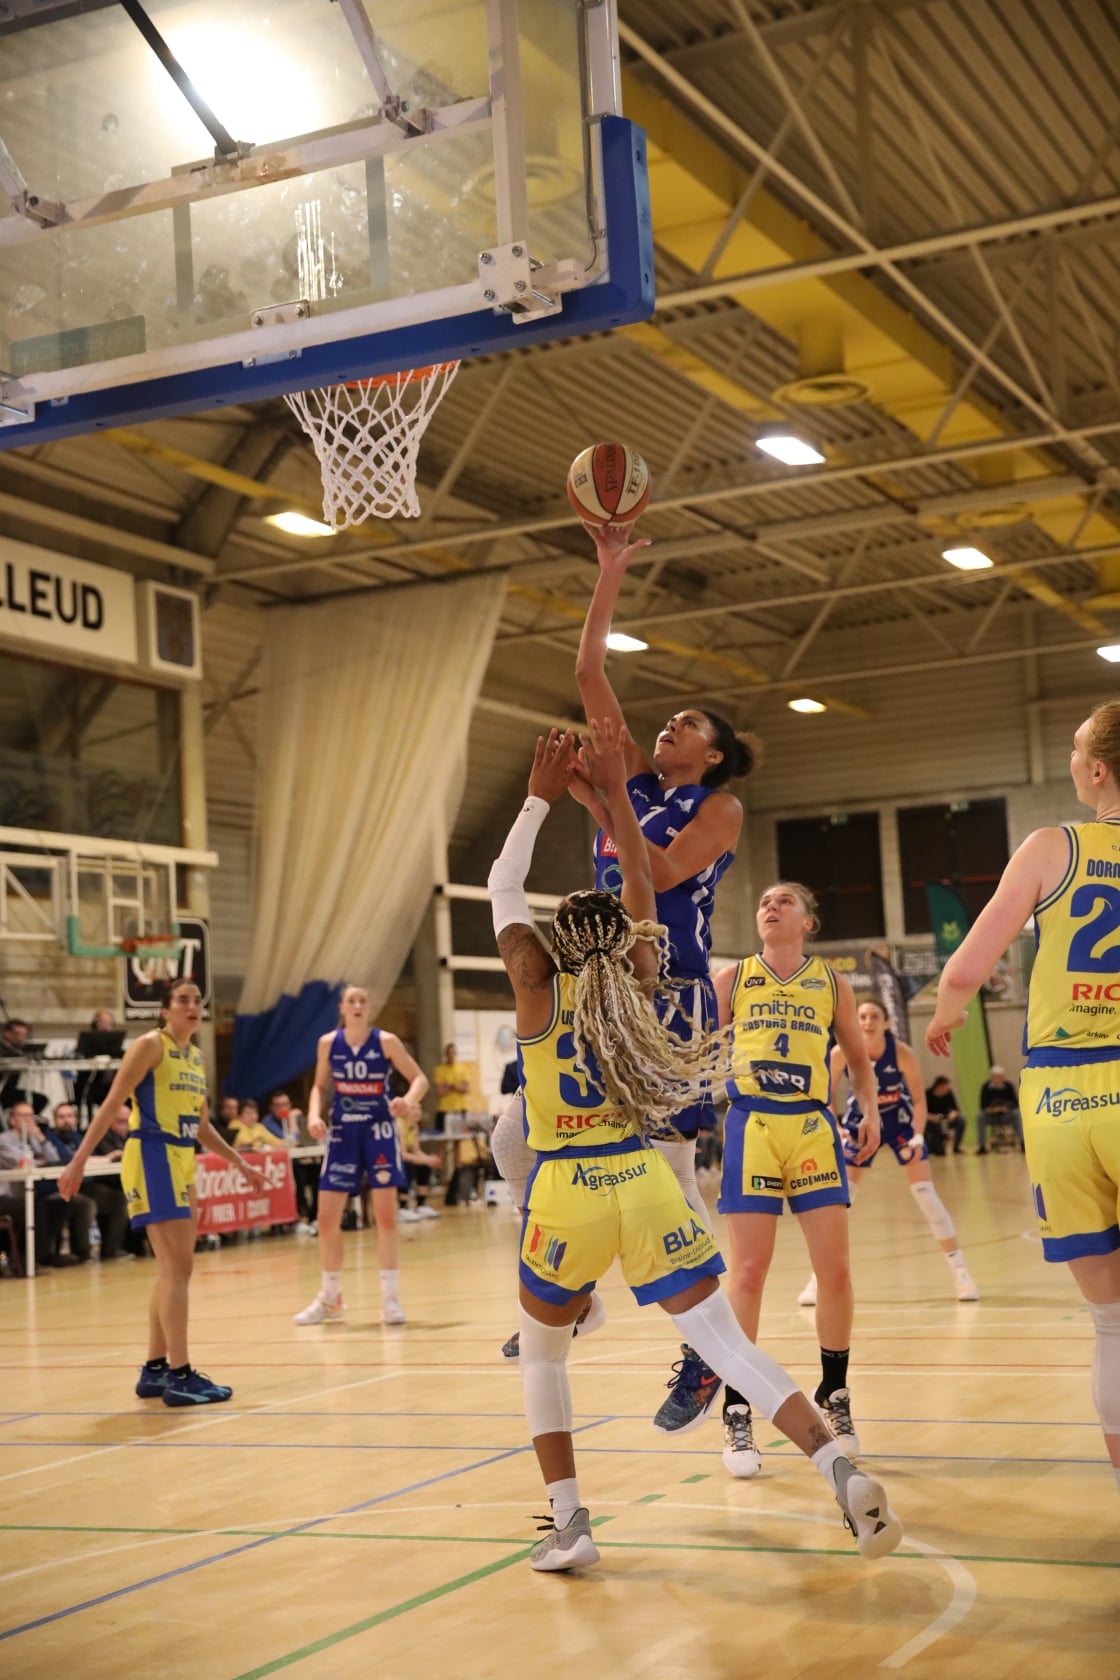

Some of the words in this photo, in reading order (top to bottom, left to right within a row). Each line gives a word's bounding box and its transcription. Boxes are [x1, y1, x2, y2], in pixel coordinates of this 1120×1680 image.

[0, 561, 104, 631] LEUD
[750, 1000, 815, 1019] mithra
[774, 1033, 789, 1058] 4
[344, 1061, 367, 1079] 10
[556, 1031, 607, 1108] 3
[371, 1122, 393, 1140] 10
[572, 1163, 647, 1191] Agreassur
[790, 1172, 838, 1189] CEDIMMO
